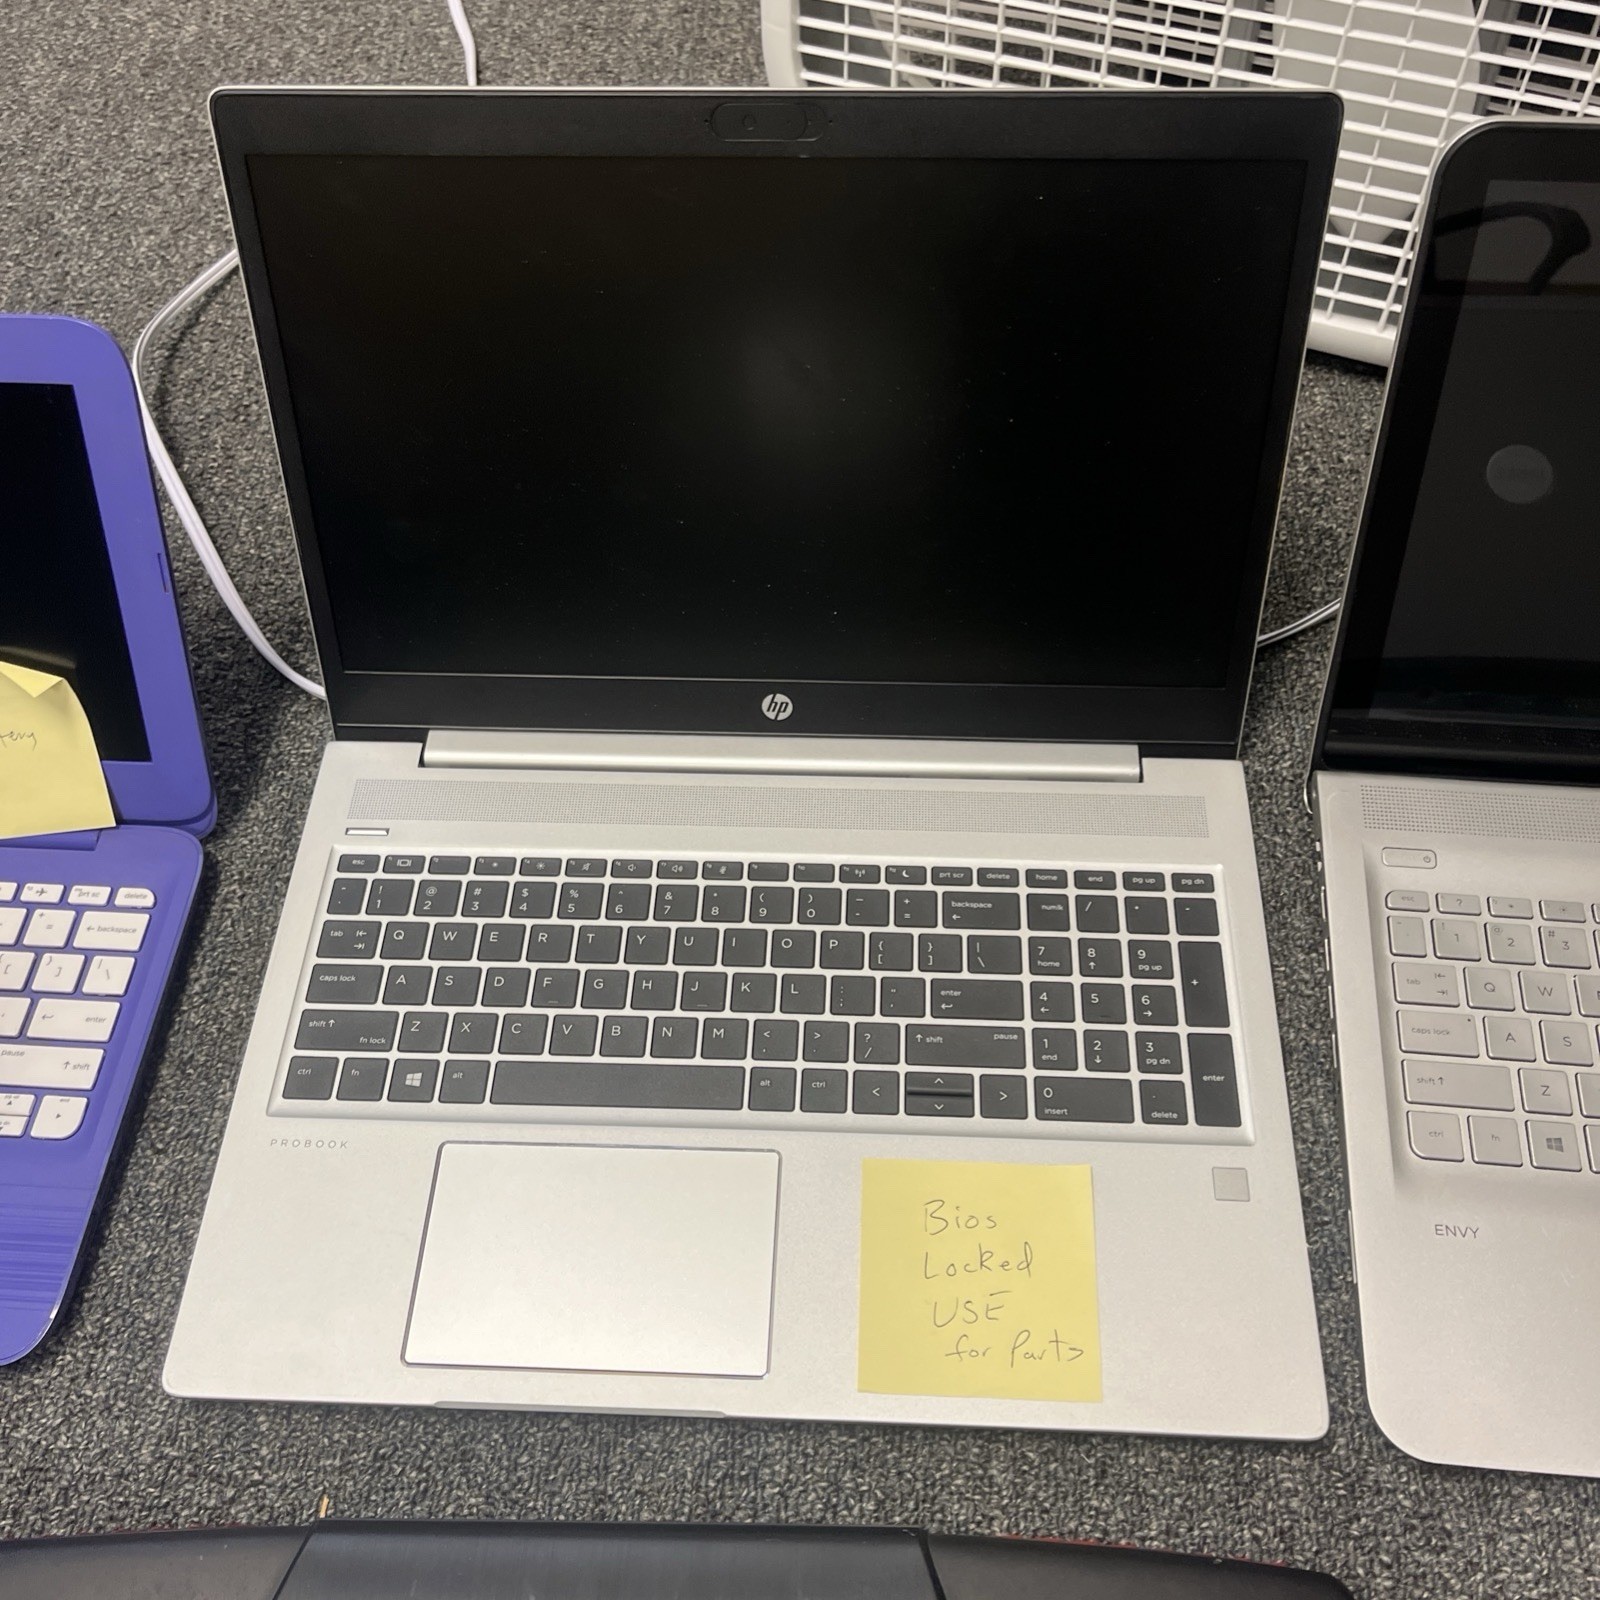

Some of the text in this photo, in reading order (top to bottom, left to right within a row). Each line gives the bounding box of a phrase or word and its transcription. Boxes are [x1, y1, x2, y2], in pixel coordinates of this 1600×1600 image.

[763, 693, 792, 721] hp
[986, 872, 1011, 880] delete
[1181, 877, 1206, 886] pg dn
[123, 892, 148, 900] delete
[425, 886, 438, 897] @
[473, 887, 482, 896] #
[521, 887, 529, 898] $
[423, 900, 432, 910] 2
[471, 901, 480, 911] 3
[519, 902, 528, 912] 4
[567, 903, 575, 913] 5
[615, 904, 623, 914] 6
[951, 901, 993, 909] backspace
[710, 906, 720, 916] 8
[759, 907, 767, 917] 9
[96, 925, 137, 934] backspace
[393, 929, 405, 940] Q
[443, 930, 458, 941] W
[489, 931, 499, 942] E
[538, 932, 548, 943] R
[586, 933, 596, 944] T
[636, 934, 647, 945] Y
[683, 936, 694, 947] U
[781, 938, 793, 949] O
[829, 939, 839, 950] P
[1507, 937, 1515, 948] 2
[1562, 940, 1570, 951] 3
[1037, 946, 1045, 956] 7
[1087, 947, 1096, 958] 8
[1137, 949, 1146, 960] 9
[1037, 960, 1061, 968] home
[1138, 964, 1150, 972] pg
[339, 974, 356, 982] lock
[395, 974, 406, 985] A
[444, 975, 454, 986] S
[494, 976, 505, 987] D
[543, 977, 553, 988] F
[1406, 978, 1421, 986] tab
[593, 978, 604, 990] G
[642, 979, 653, 990] H
[690, 981, 699, 992] J
[741, 982, 751, 993] K
[790, 983, 799, 994] L
[1483, 982, 1496, 993] Q
[940, 989, 962, 997] enter
[1039, 992, 1048, 1002] 4
[1537, 986, 1553, 997] W
[1090, 993, 1099, 1004] 5
[1141, 995, 1151, 1006] 6
[308, 1020, 327, 1028] shift
[410, 1020, 421, 1032] Z
[460, 1022, 472, 1033] X
[511, 1022, 522, 1034] C
[562, 1024, 573, 1035] V
[611, 1025, 621, 1037] B
[661, 1026, 673, 1037] N
[712, 1028, 725, 1039] M
[1411, 1027, 1450, 1036] caps lock
[359, 1036, 386, 1044] fn lock
[925, 1036, 943, 1044] shift
[1505, 1032, 1517, 1043] A
[1562, 1036, 1572, 1048] S
[1093, 1040, 1102, 1051] 2
[1145, 1041, 1154, 1053] 3
[72, 1063, 90, 1071] shift
[1145, 1057, 1171, 1066] pg dn
[351, 1068, 360, 1076] fn
[452, 1071, 464, 1079] alt
[759, 1079, 771, 1087] alt
[1416, 1077, 1436, 1086] shift
[1540, 1084, 1551, 1097] Z
[1044, 1108, 1068, 1116] insert
[1151, 1111, 1178, 1119] delete
[270, 1138, 348, 1149] PROBOOK
[923, 1198, 998, 1236] Bios
[1434, 1223, 1480, 1239] ENVY
[923, 1240, 1034, 1280] Locked
[932, 1289, 1012, 1329] USE
[944, 1333, 992, 1362] for
